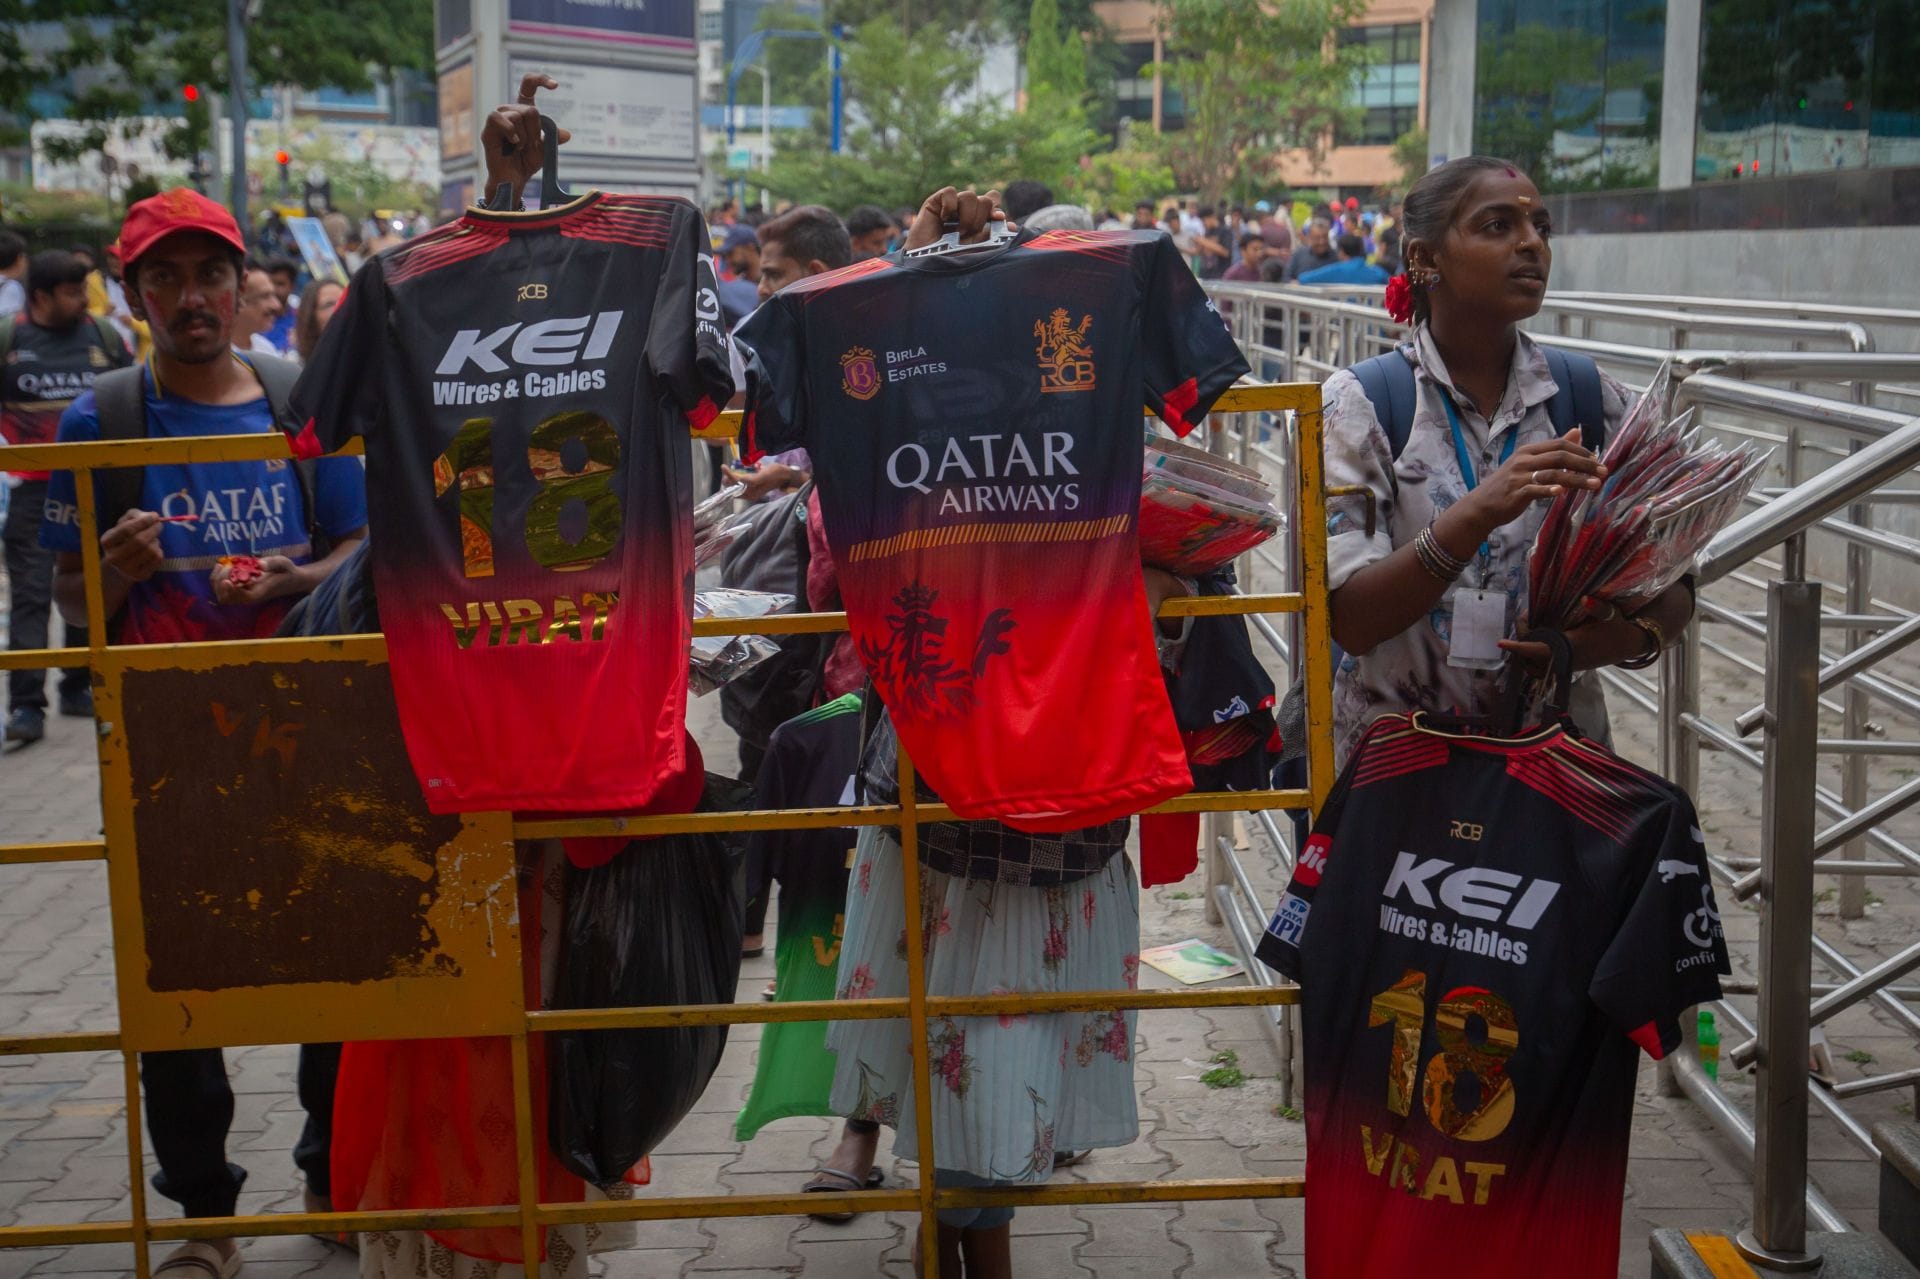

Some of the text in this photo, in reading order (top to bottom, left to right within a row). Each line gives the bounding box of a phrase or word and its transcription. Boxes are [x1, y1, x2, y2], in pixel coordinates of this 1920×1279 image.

[517, 283, 549, 303] RCB
[435, 310, 624, 375] KEI
[433, 369, 606, 405] Wires & Cables
[1038, 361, 1096, 387] RCB
[886, 431, 1081, 495] QATAR
[433, 410, 626, 578] 18
[939, 483, 1080, 515] AIRWAYS
[440, 591, 619, 650] VIRAT
[1450, 820, 1484, 841] RCB
[1382, 852, 1562, 930] KEI
[1430, 922, 1449, 946] &
[1368, 968, 1519, 1142] 18
